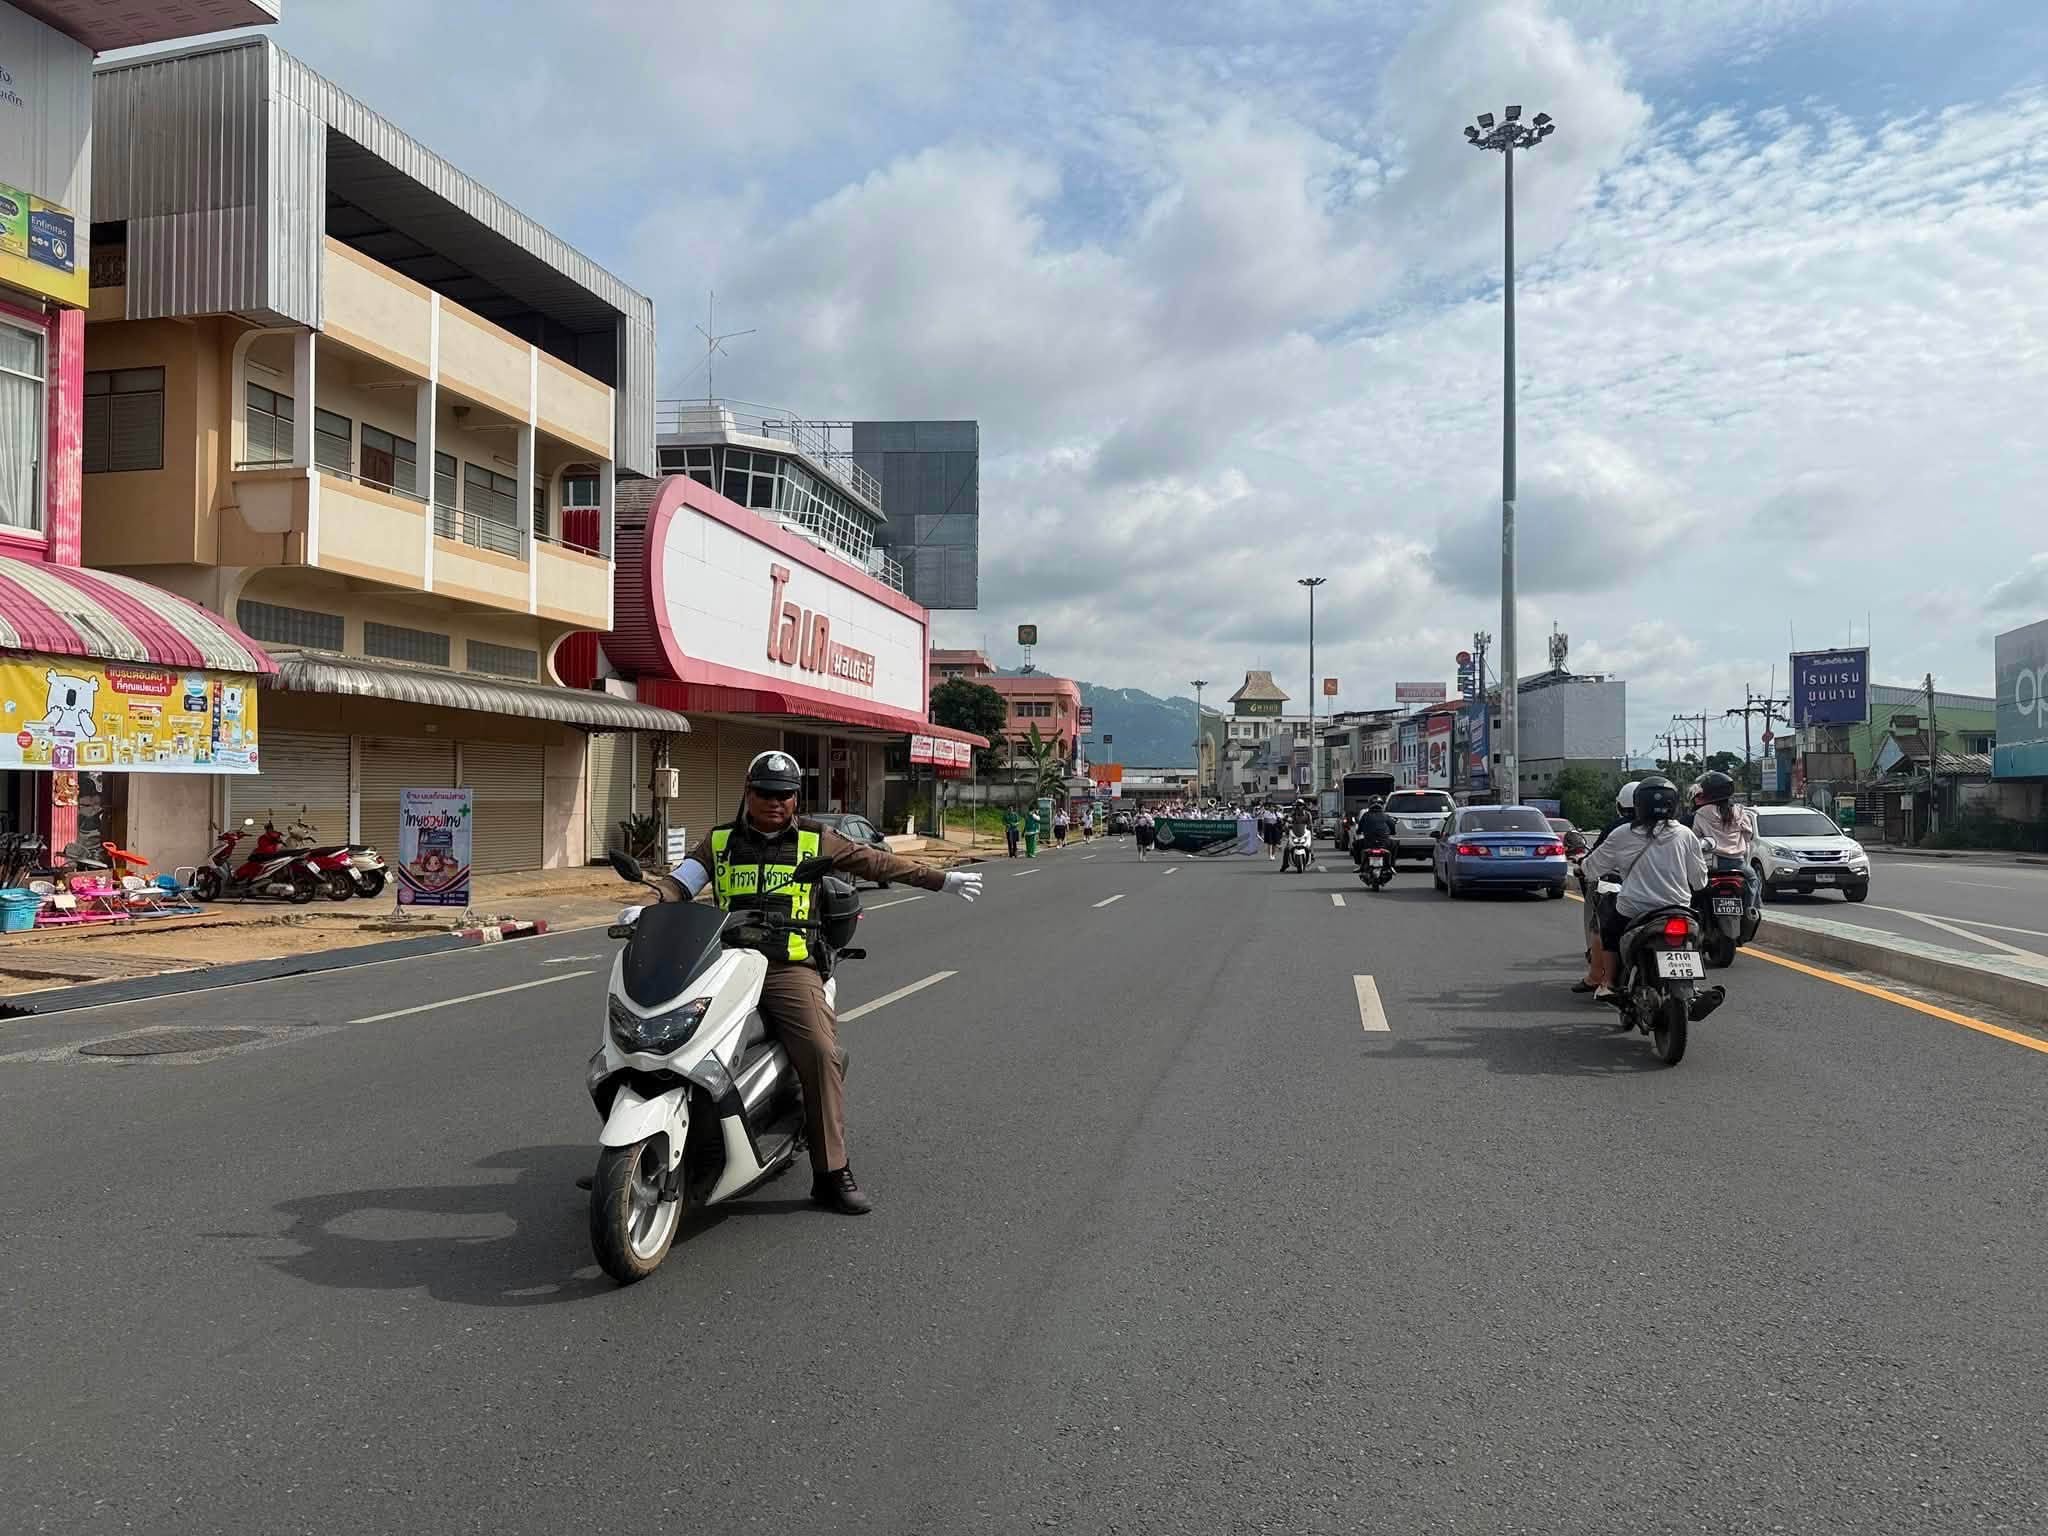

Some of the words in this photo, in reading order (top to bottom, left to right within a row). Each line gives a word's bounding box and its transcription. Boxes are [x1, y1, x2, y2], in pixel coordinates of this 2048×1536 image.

[31, 215, 68, 238] Enfinitas
[1802, 668, 1860, 686] โรงแรม
[404, 807, 462, 829] ไทยช่วยไทย
[730, 868, 757, 889] ตำรวจ
[1670, 968, 1694, 977] 415
